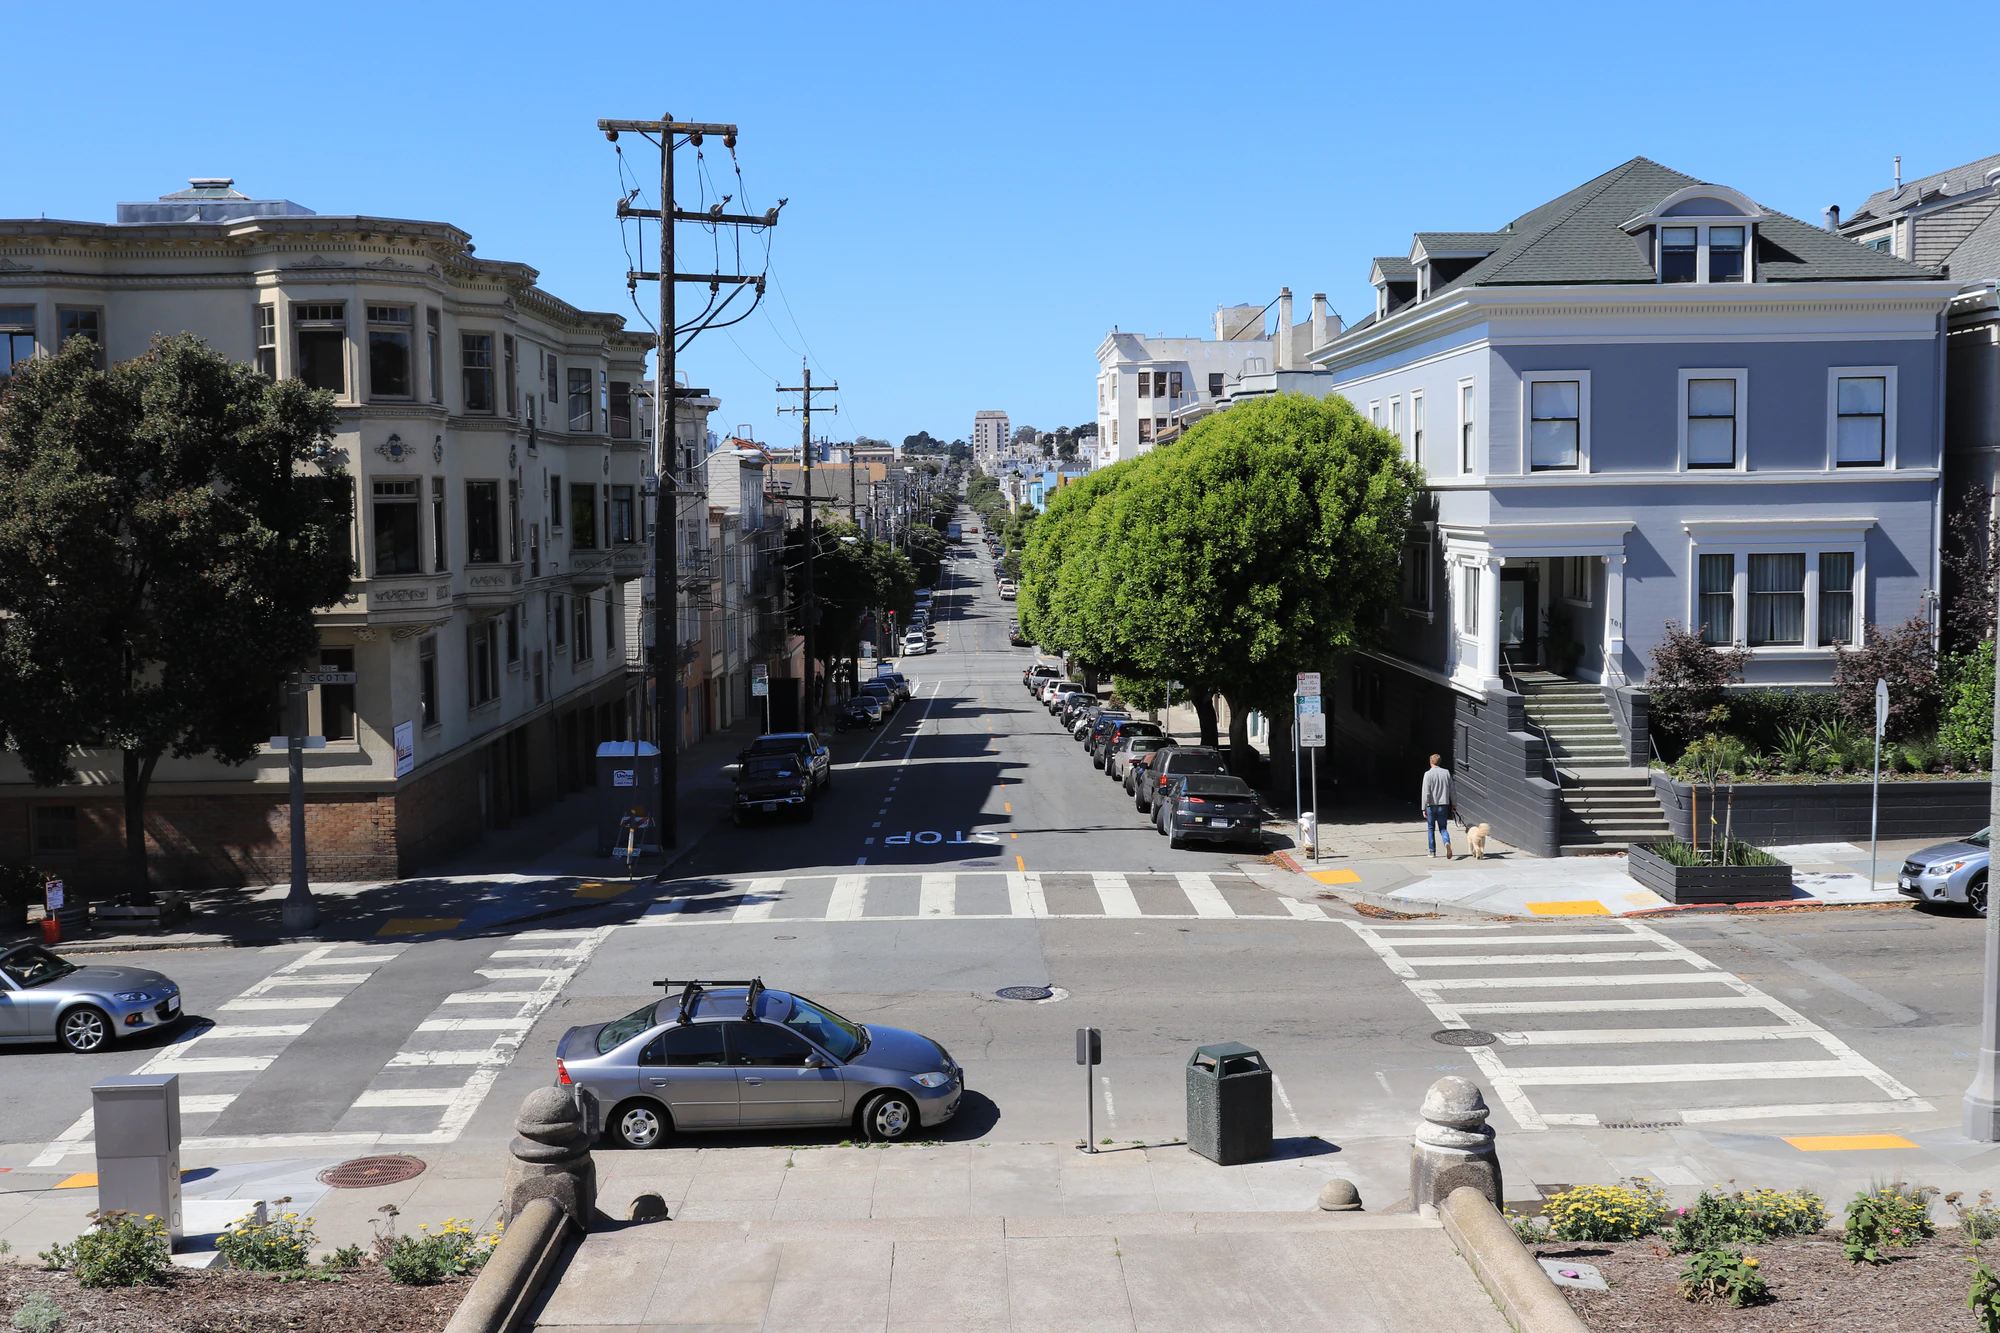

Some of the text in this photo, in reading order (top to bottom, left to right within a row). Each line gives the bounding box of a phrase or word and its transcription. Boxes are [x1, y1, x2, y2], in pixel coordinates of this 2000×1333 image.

[1610, 618, 1622, 629] 701
[309, 674, 348, 682] SCOTT
[885, 831, 999, 844] STOP
